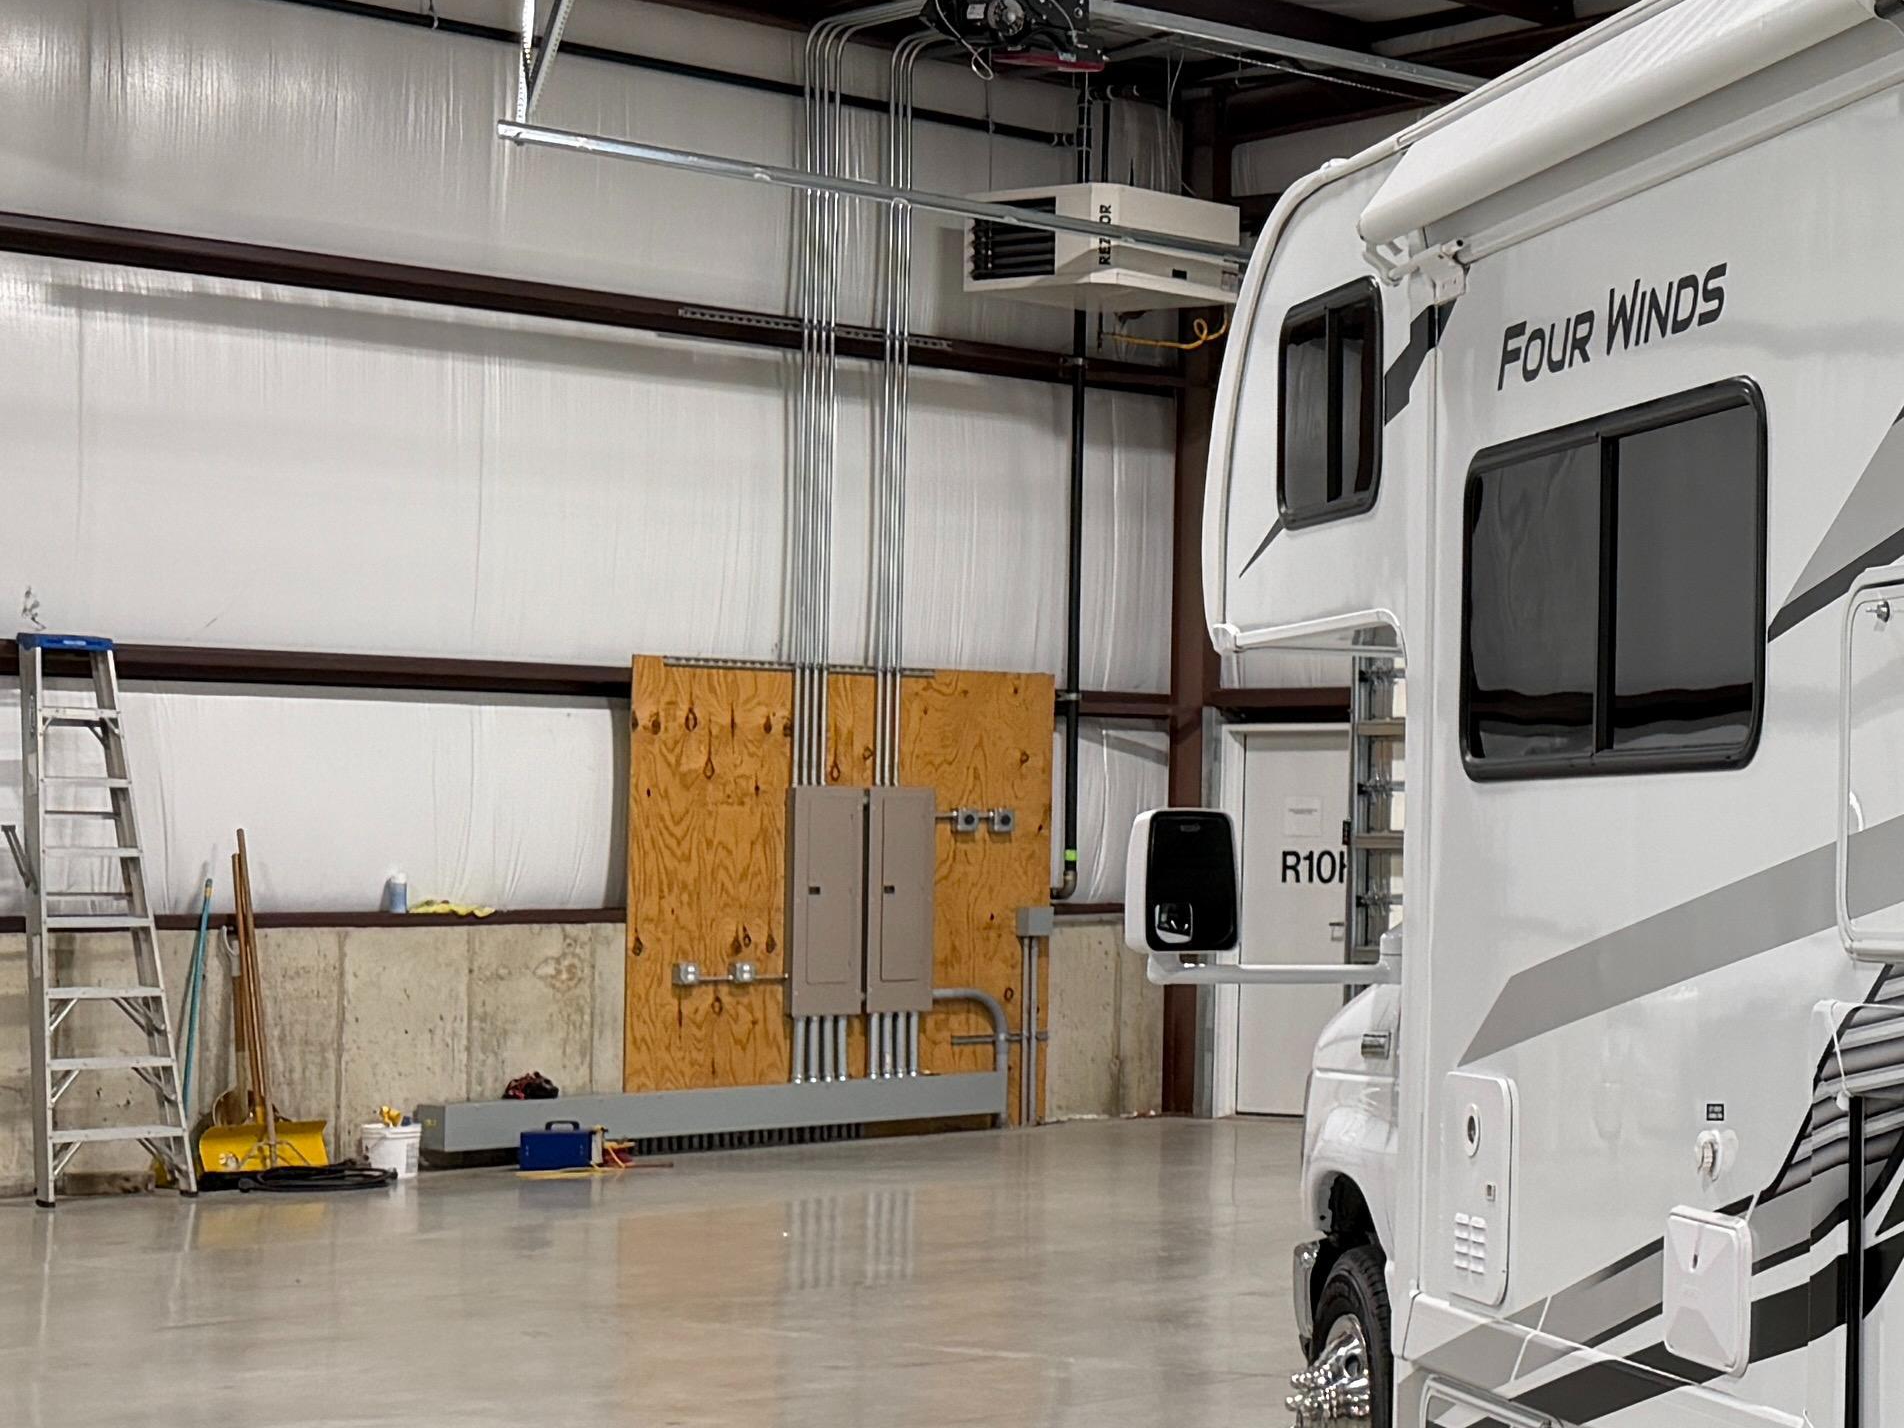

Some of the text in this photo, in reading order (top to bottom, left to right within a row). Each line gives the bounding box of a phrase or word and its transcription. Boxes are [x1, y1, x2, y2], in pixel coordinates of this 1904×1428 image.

[1099, 204, 1112, 265] REZOR
[1497, 262, 1728, 391] FOUR WINDS
